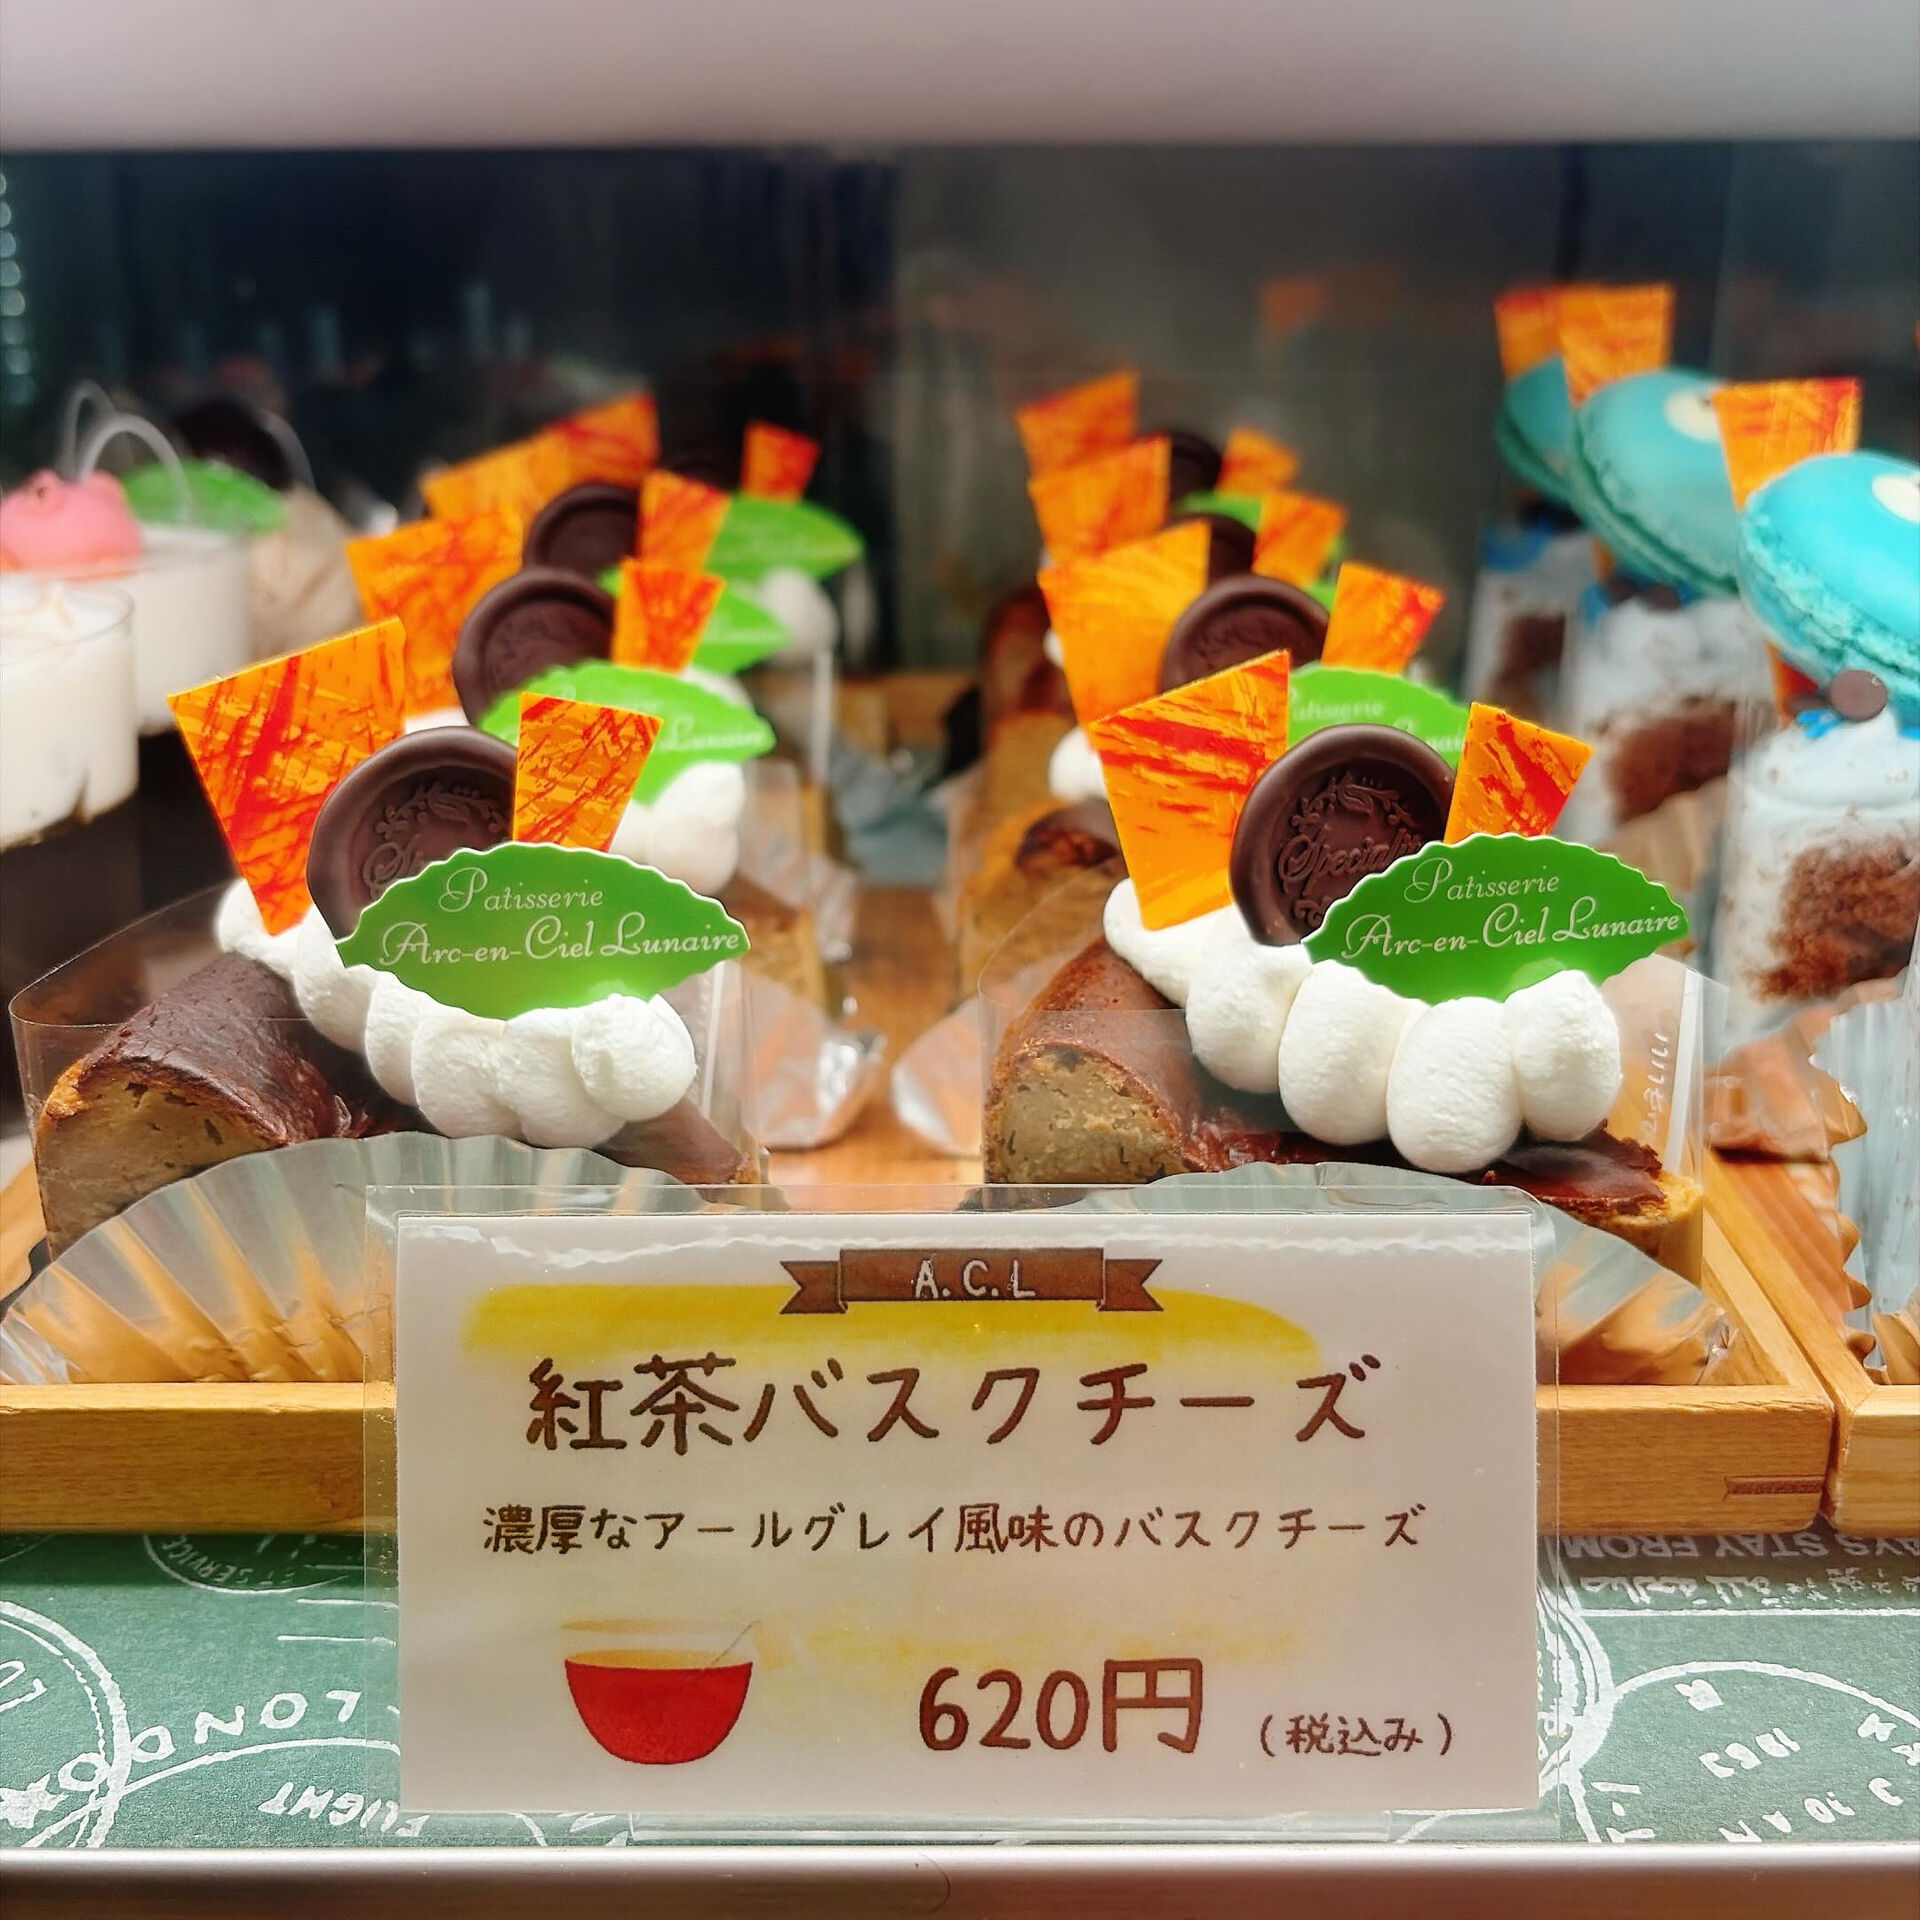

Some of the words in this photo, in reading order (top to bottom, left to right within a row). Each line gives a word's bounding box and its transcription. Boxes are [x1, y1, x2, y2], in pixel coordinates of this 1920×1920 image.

[438, 866, 604, 913] Patisserie
[1403, 857, 1560, 903] Patisserie
[379, 915, 595, 965] Arc-en-Ciel
[600, 911, 740, 957] Lunaire
[1340, 901, 1548, 959] Arc-en-Ciel
[1552, 895, 1681, 941] Lunaire
[914, 1259, 1036, 1299] A.C.L
[525, 1351, 1382, 1457] 紅茶バスクチーズ
[483, 1501, 1427, 1555] 濃厚なアールグレイ風味のバスクチーズ
[1561, 1535, 1700, 1557] FROM
[1715, 1531, 1829, 1557] STAY
[918, 1657, 1204, 1754] 620円
[1260, 1712, 1453, 1758] (税込み)
